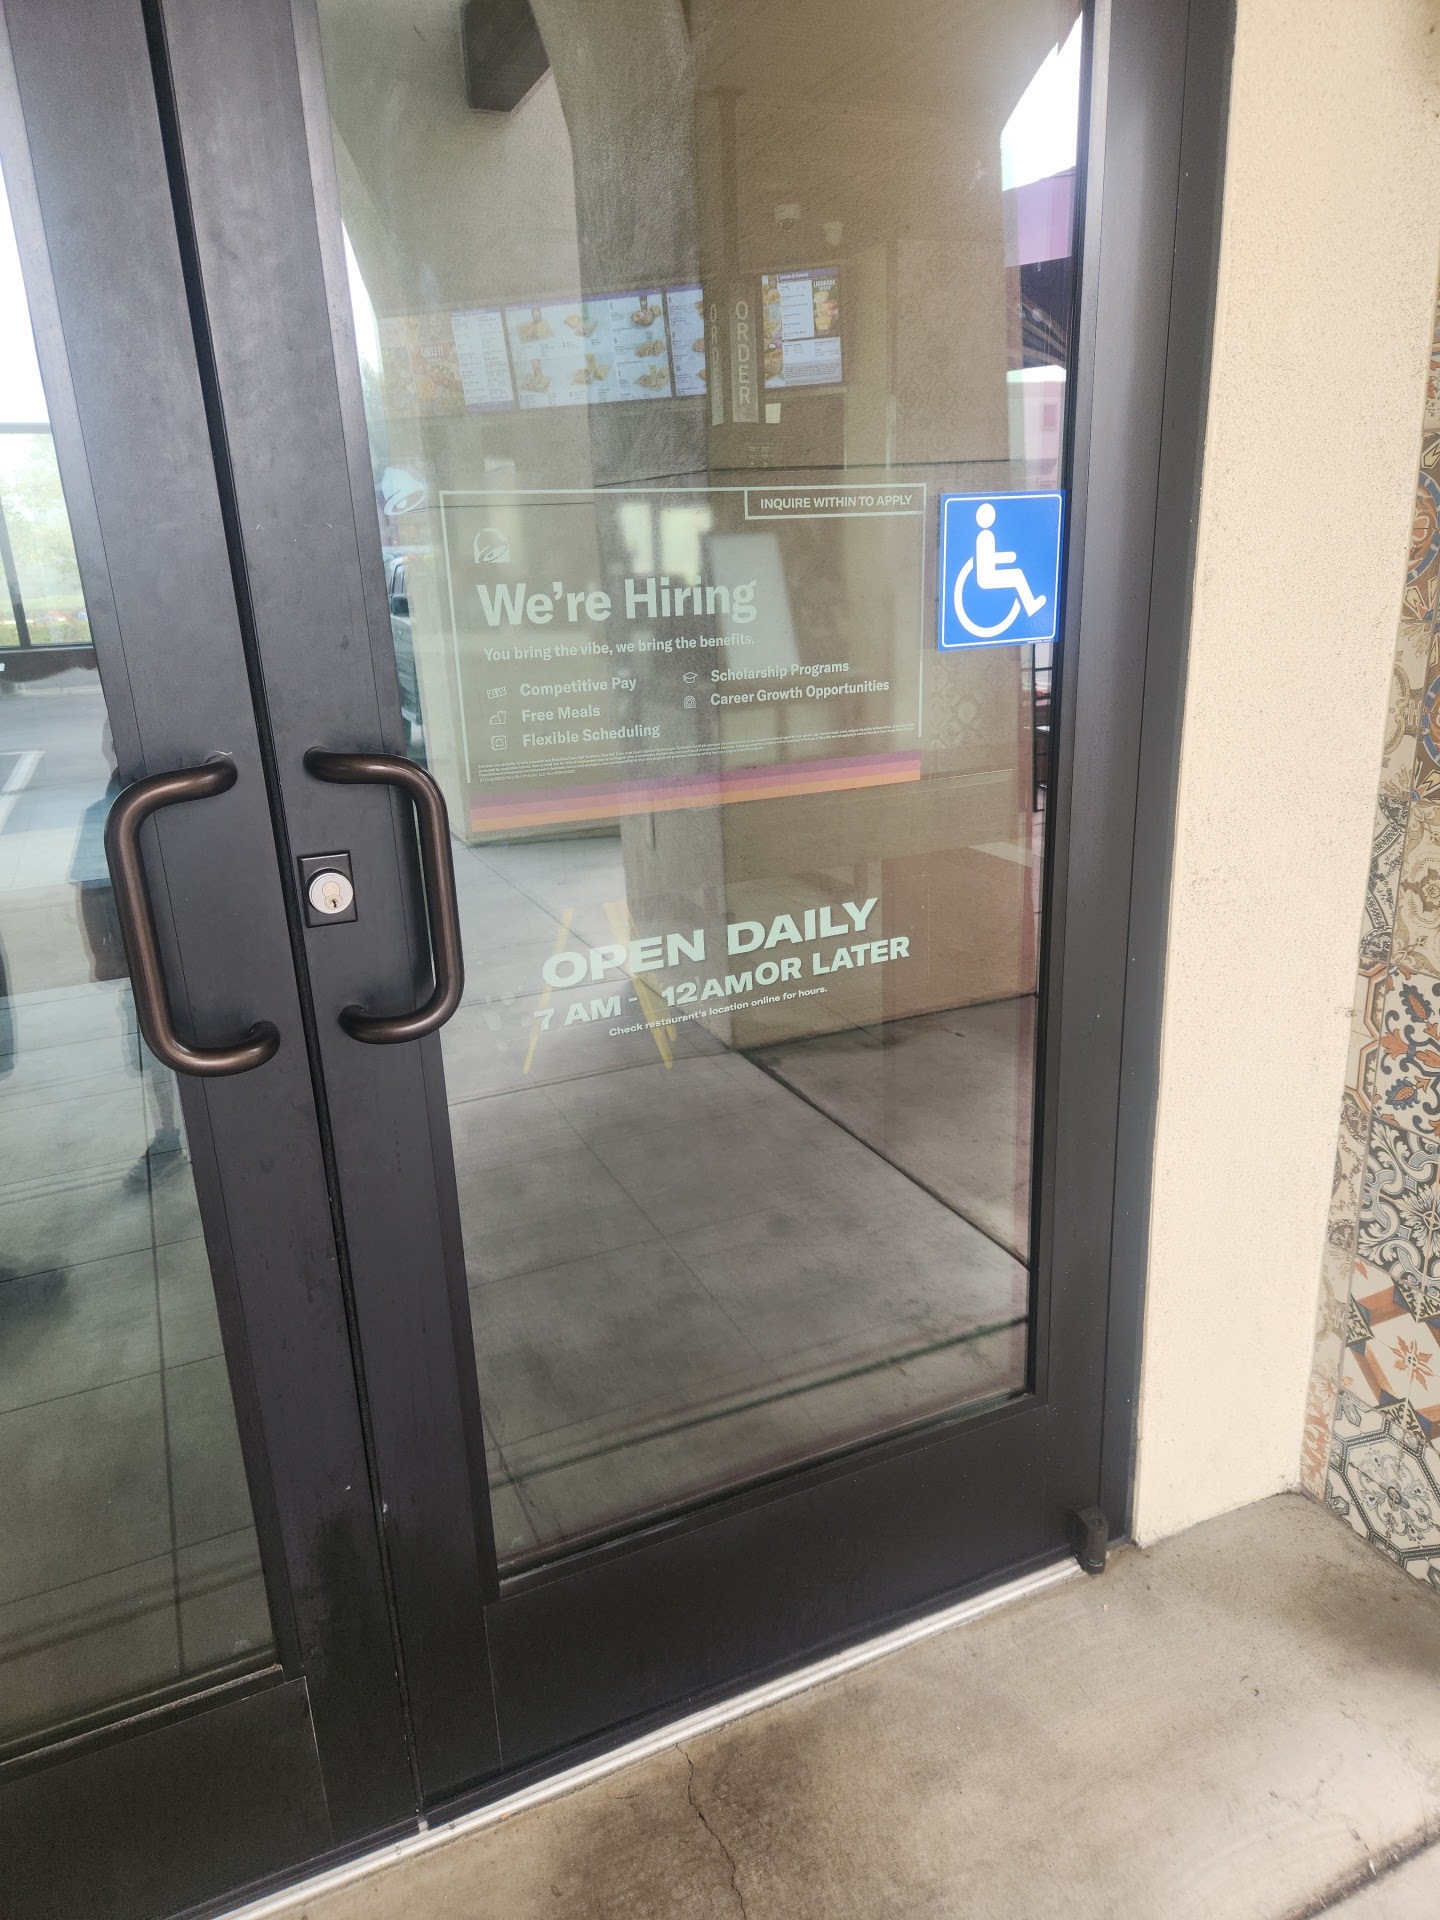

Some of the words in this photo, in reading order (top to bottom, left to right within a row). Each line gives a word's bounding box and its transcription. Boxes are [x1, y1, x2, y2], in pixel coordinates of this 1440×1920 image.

[735, 300, 750, 404] ORDER
[760, 498, 811, 511] INQUIRE
[813, 496, 859, 508] WITHIN
[859, 496, 876, 506] TO
[876, 494, 913, 506] APPLY
[624, 577, 758, 623] Hiring
[483, 648, 511, 661] You
[514, 646, 552, 660] bring
[554, 643, 577, 657] the
[581, 641, 613, 656] vibe,
[616, 641, 636, 653] we
[640, 637, 673, 652] bring
[675, 637, 697, 650] the
[700, 632, 756, 648] benefits.
[711, 667, 787, 682] Scholarship
[790, 662, 850, 677] Programs
[520, 679, 608, 697] Competitive
[611, 677, 637, 691] Pay
[711, 691, 755, 706] Career
[757, 685, 803, 701] Growth
[806, 680, 890, 698] Opportunities
[521, 710, 554, 722] Free
[558, 705, 601, 719] Meals
[522, 730, 579, 747] Flexible
[582, 724, 661, 742] Scheduling
[542, 928, 706, 988] OPEN
[727, 897, 879, 956] DAILY
[533, 1008, 555, 1030] 7
[564, 995, 622, 1026] AM
[812, 936, 910, 976] LATER
[609, 1024, 643, 1036] Check
[709, 1001, 749, 1015] location
[751, 994, 781, 1008] online
[782, 992, 796, 1001] for
[798, 986, 828, 998] hours.
